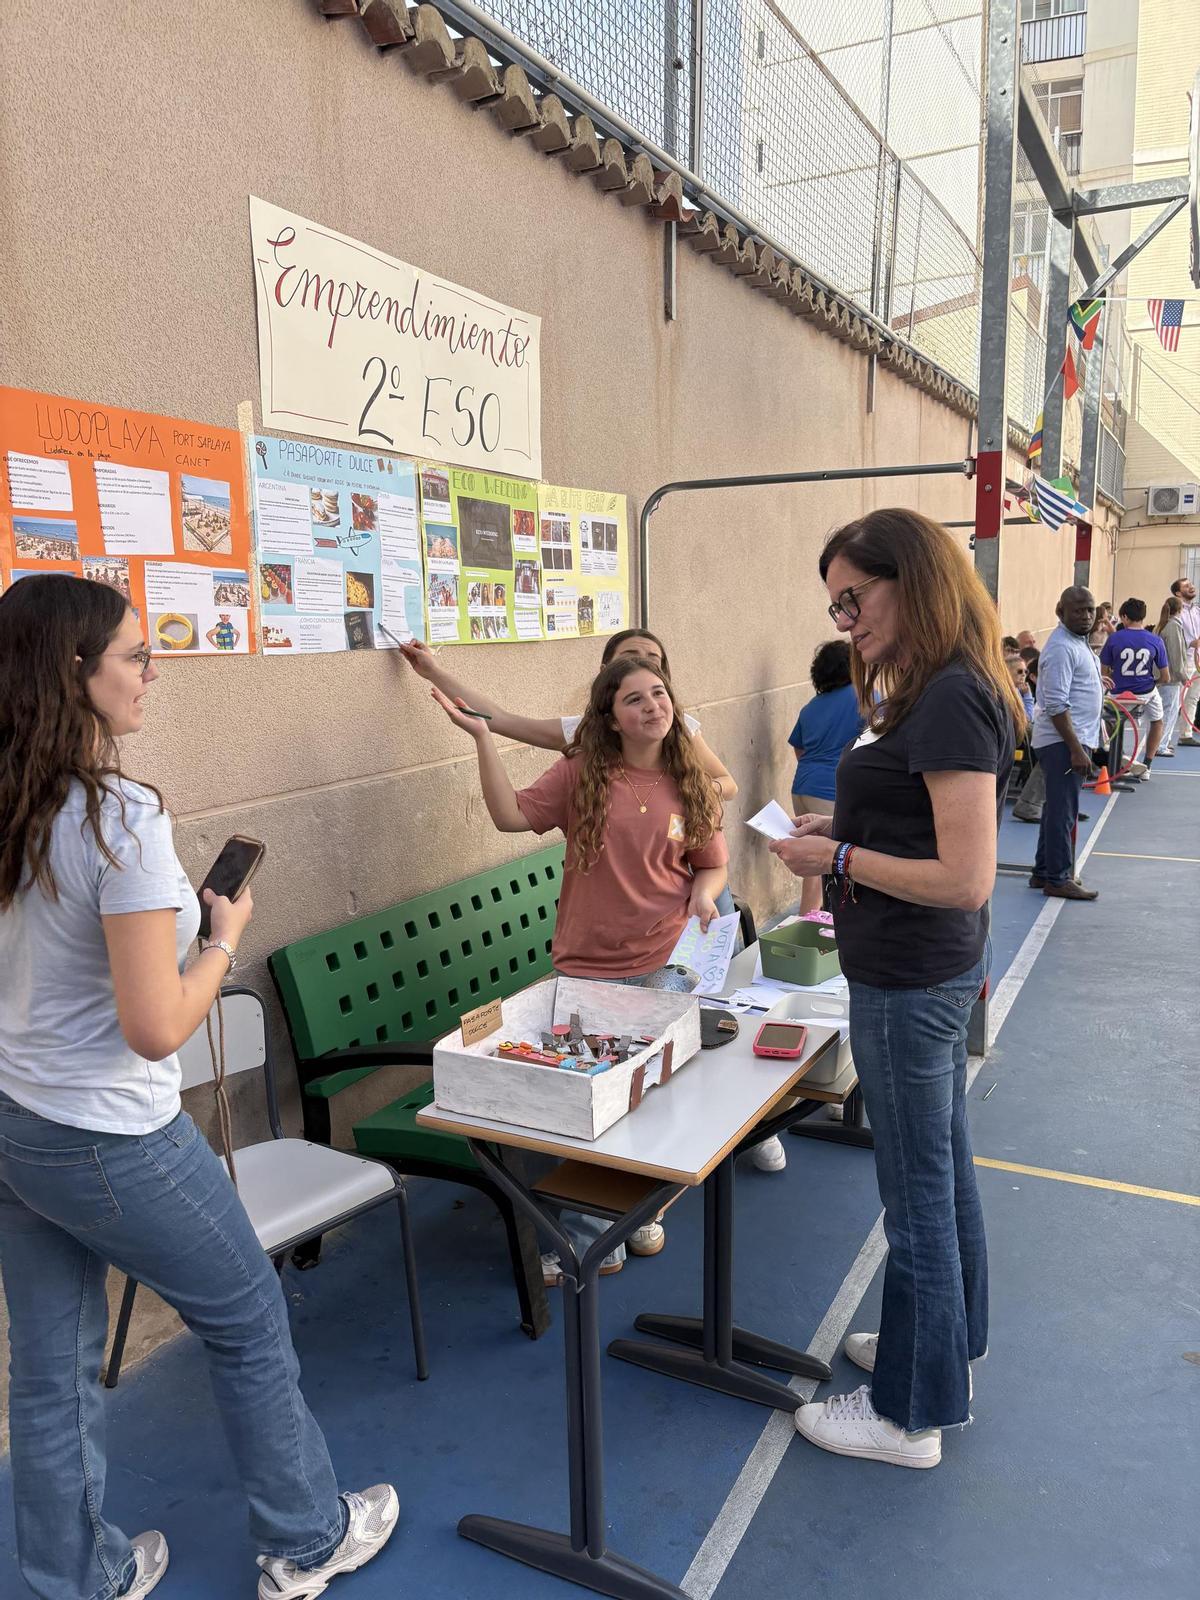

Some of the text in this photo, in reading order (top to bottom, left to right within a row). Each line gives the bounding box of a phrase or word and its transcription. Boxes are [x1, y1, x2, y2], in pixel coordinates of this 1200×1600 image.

[266, 226, 530, 368] Emprendimiento
[423, 375, 501, 453] ESO
[36, 402, 166, 458] LUDOPLAYA
[173, 430, 231, 452] PORT SAPLAYA
[176, 454, 210, 467] CANET
[279, 439, 374, 473] PASAPORTE DULCE
[453, 471, 476, 491] ECO
[1120, 647, 1151, 677] 22
[707, 922, 732, 962] VOTA
[463, 1004, 499, 1025] PASAPORTE
[468, 1021, 488, 1036] DULCE
